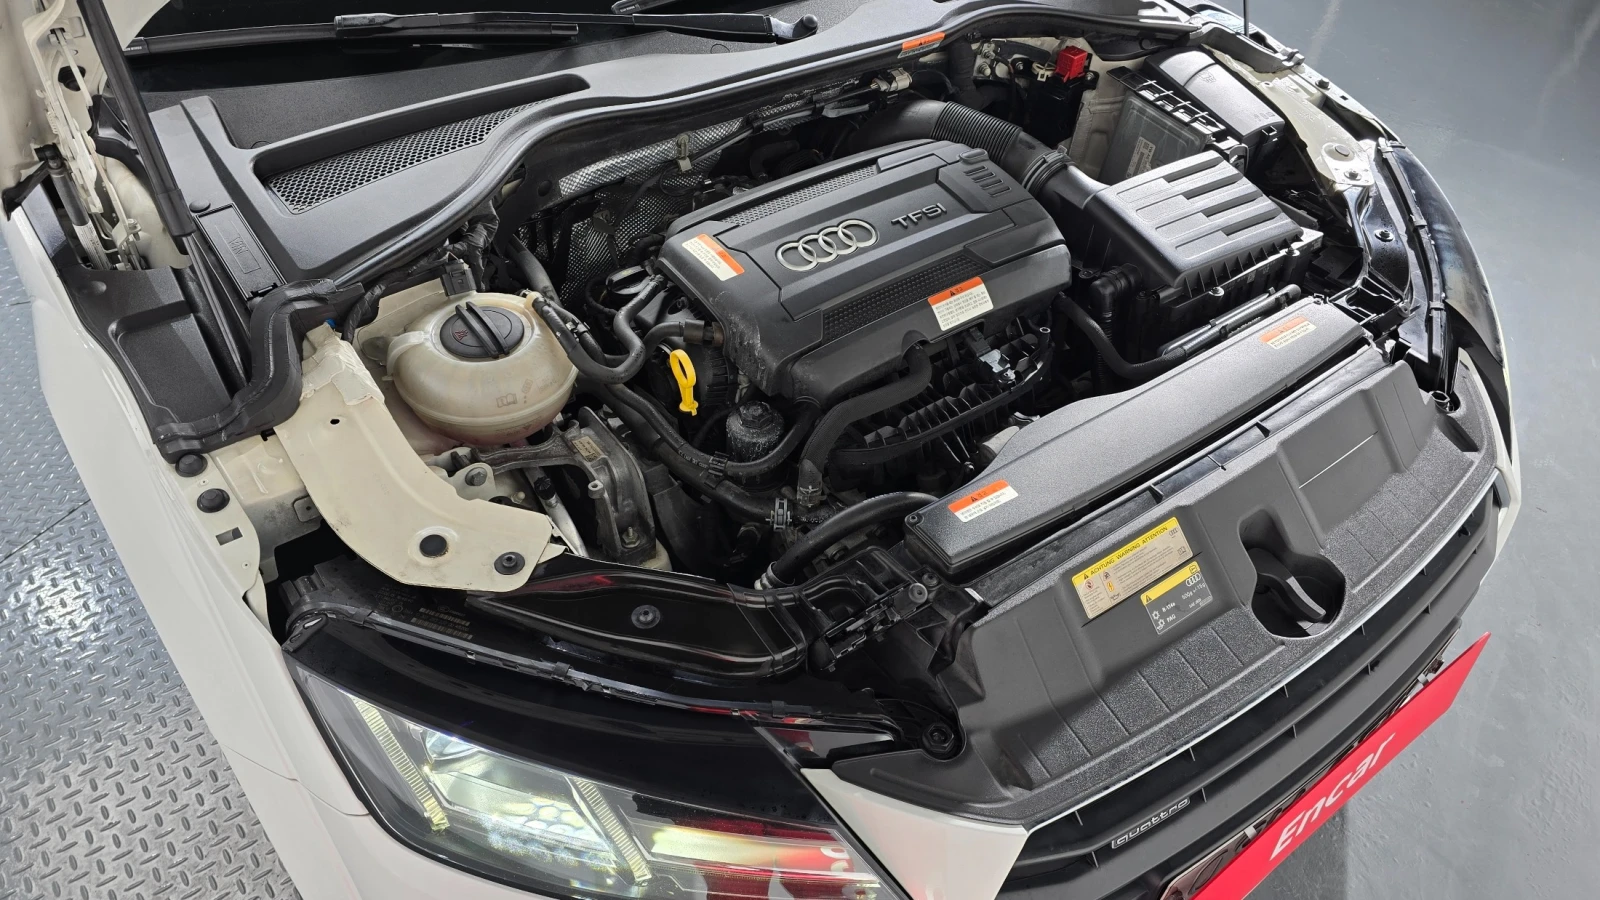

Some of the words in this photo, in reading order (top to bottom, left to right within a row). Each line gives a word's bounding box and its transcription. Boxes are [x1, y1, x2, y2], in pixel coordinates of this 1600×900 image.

[891, 203, 947, 227] TFSI
[1090, 558, 1115, 576] ACHTUNG
[1116, 543, 1141, 560] WARNING
[1141, 526, 1168, 544] ATTENTION
[1269, 732, 1396, 861] Encar
[1111, 797, 1191, 849] quattro
